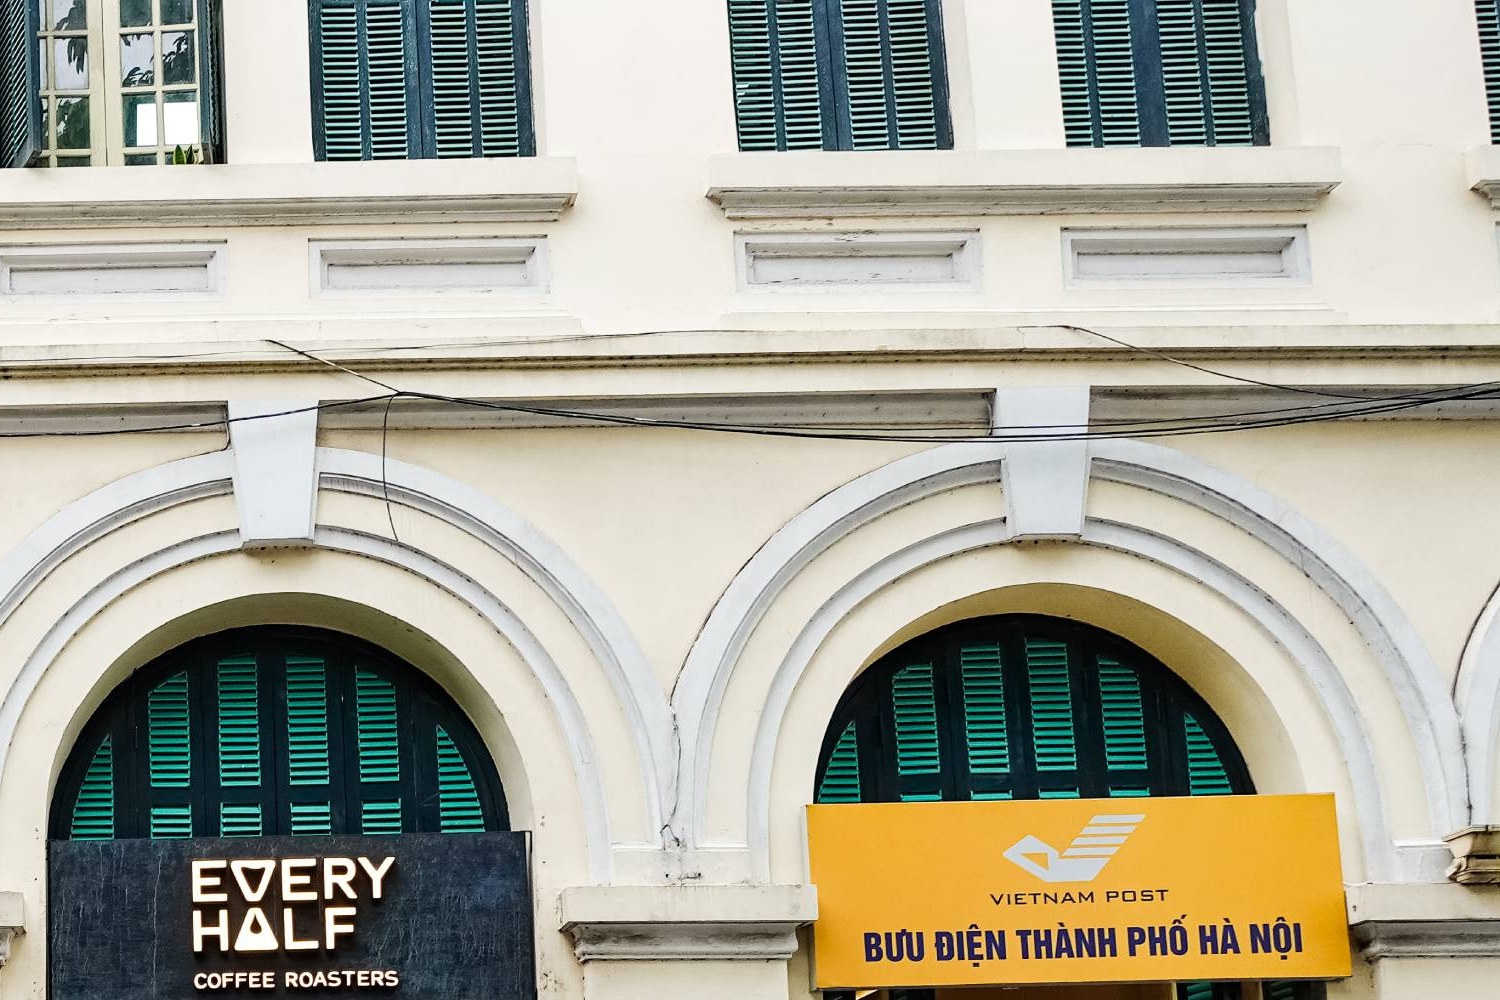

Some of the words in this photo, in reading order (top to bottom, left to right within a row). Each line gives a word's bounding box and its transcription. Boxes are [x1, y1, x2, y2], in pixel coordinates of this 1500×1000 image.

[191, 856, 396, 902] EVERY
[989, 891, 1095, 906] VIETNAM
[1105, 889, 1169, 903] POST
[192, 906, 357, 952] HALF
[863, 927, 925, 963] BƯU
[934, 923, 1007, 968] ĐIỆN
[1015, 921, 1118, 960] THÀNH
[1126, 913, 1189, 957] PHỐ
[1198, 917, 1242, 955] HÀ
[1249, 916, 1303, 961] NỘI
[193, 972, 276, 990] COFFEE
[285, 970, 399, 988] ROASTERS
